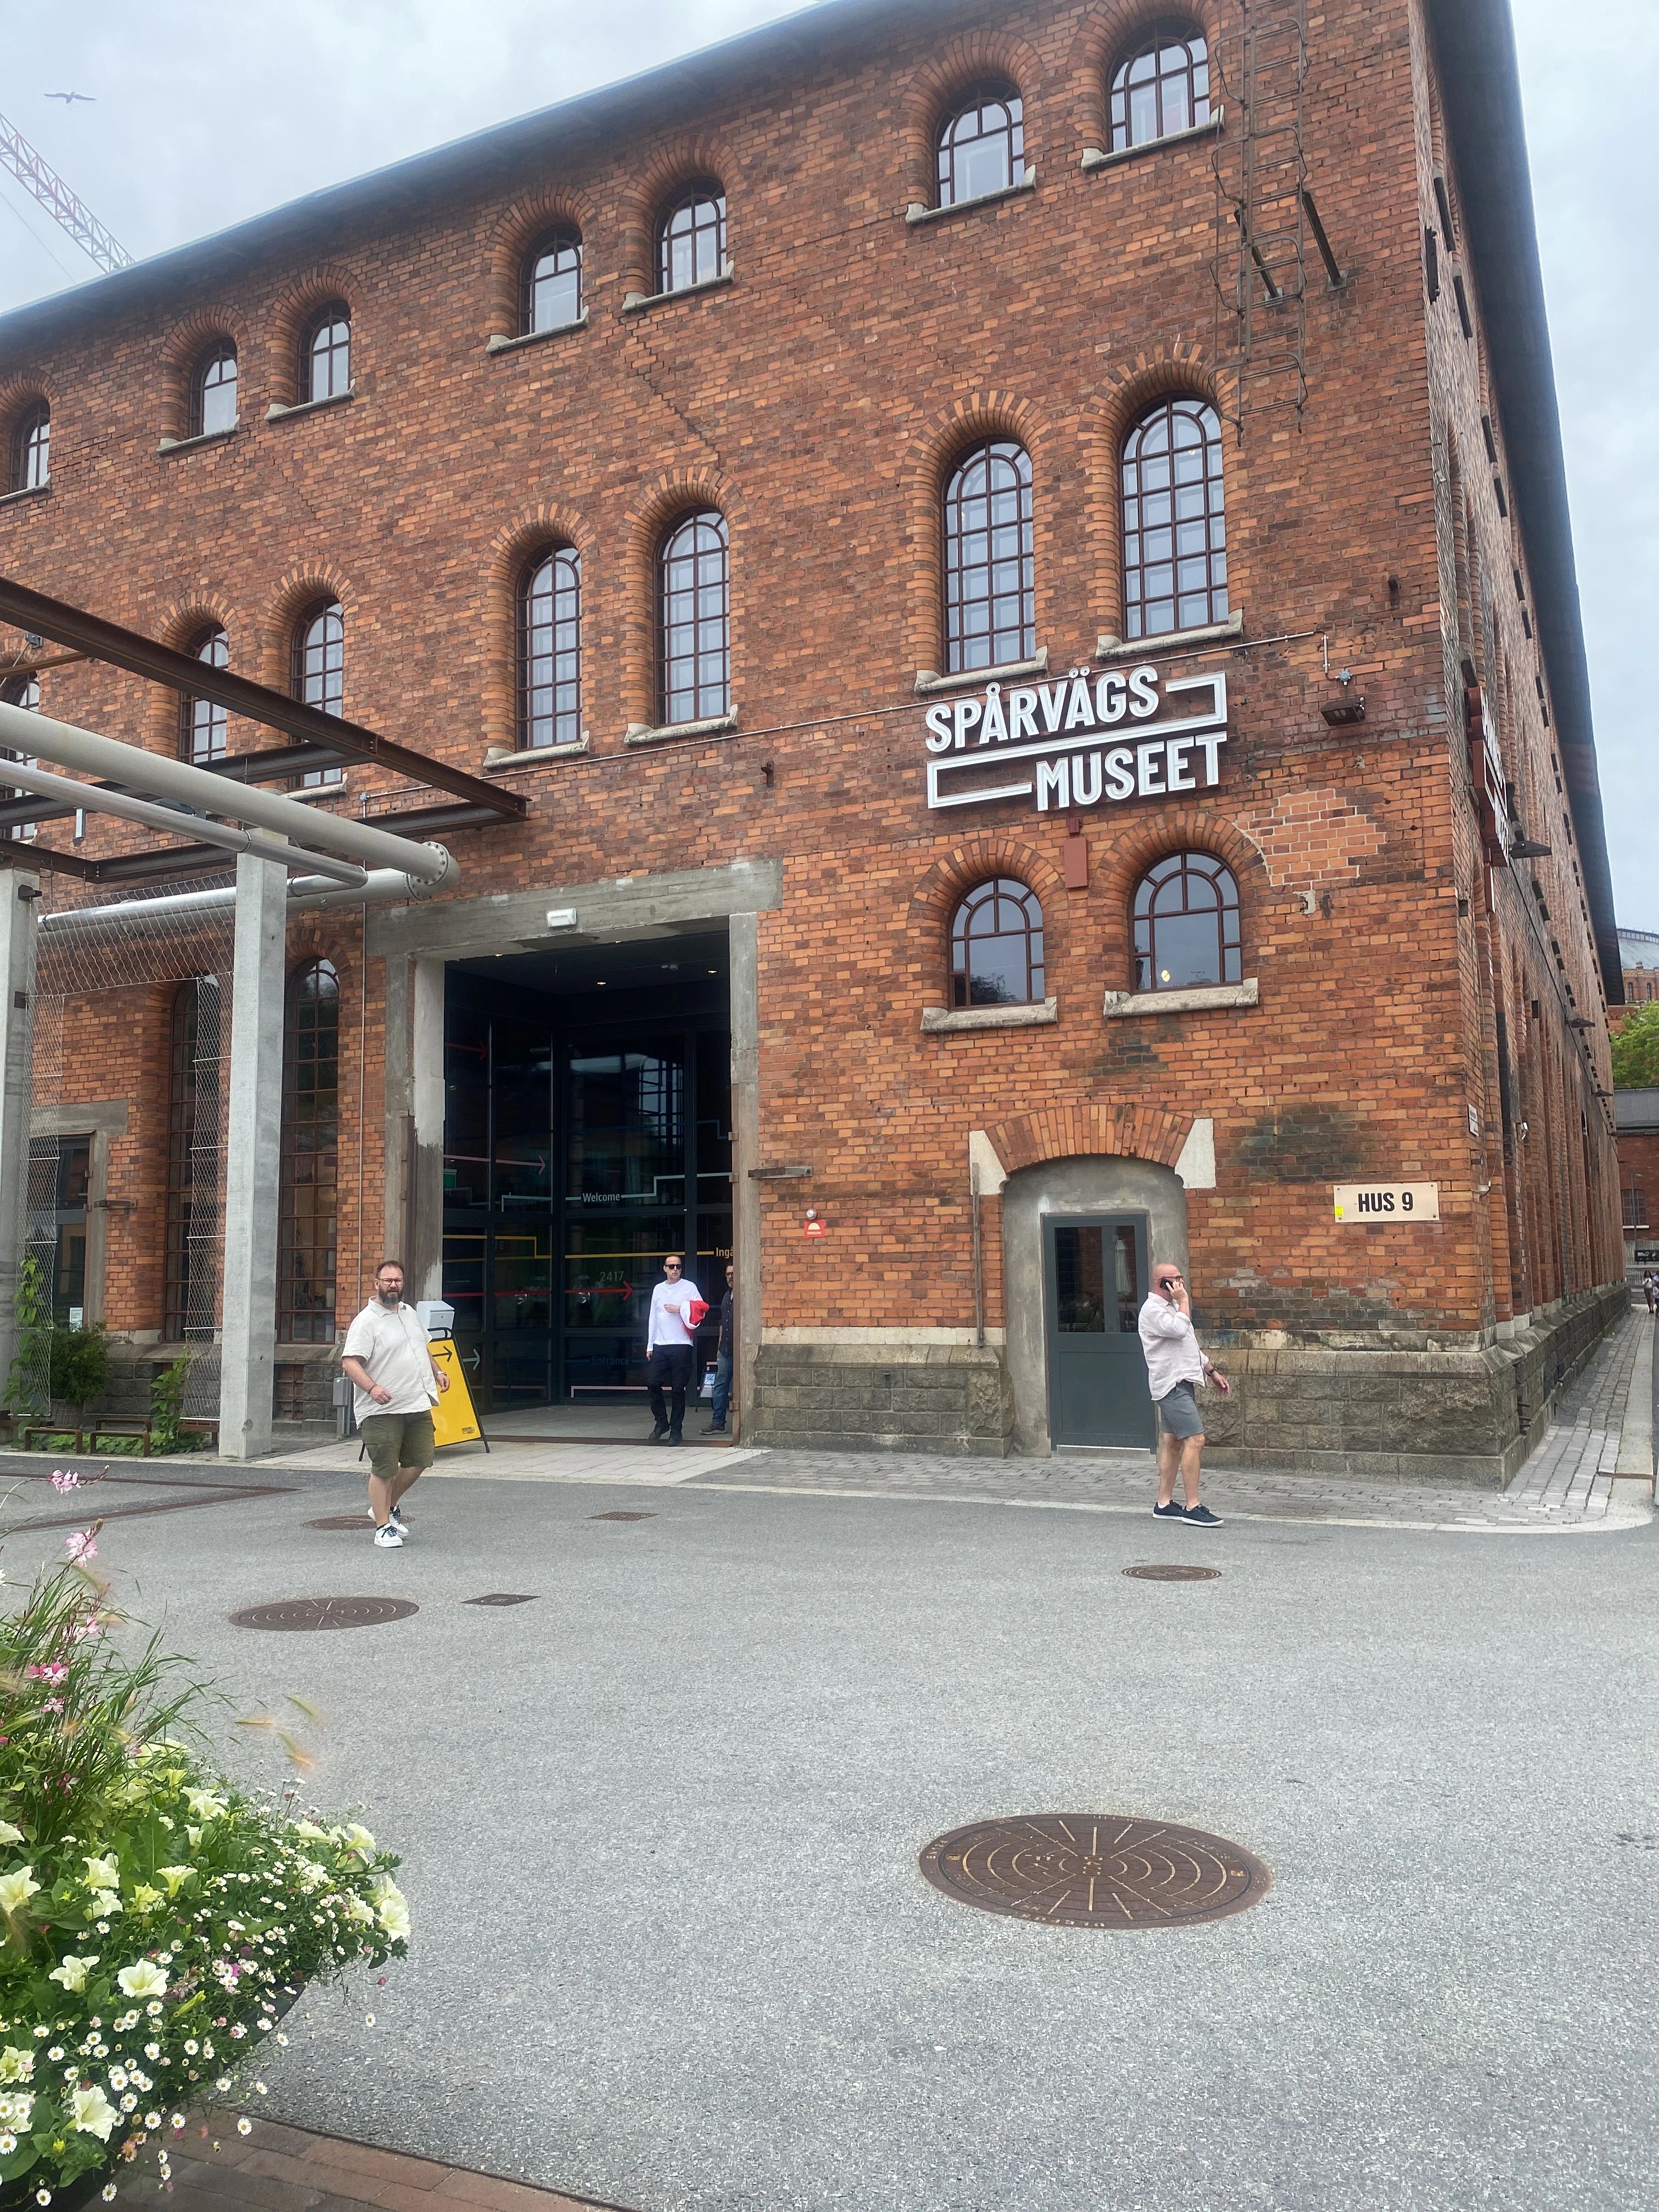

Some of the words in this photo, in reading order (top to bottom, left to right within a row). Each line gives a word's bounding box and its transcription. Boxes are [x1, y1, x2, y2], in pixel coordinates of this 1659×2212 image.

[925, 665, 1159, 753] SPÅRVÄGS
[1036, 731, 1227, 811] MUSEET
[583, 1192, 620, 1203] Welcome
[1358, 1192, 1395, 1212] HUS
[1402, 1192, 1413, 1211] 9
[600, 1271, 624, 1282] 2417
[592, 1356, 630, 1365] Entrance
